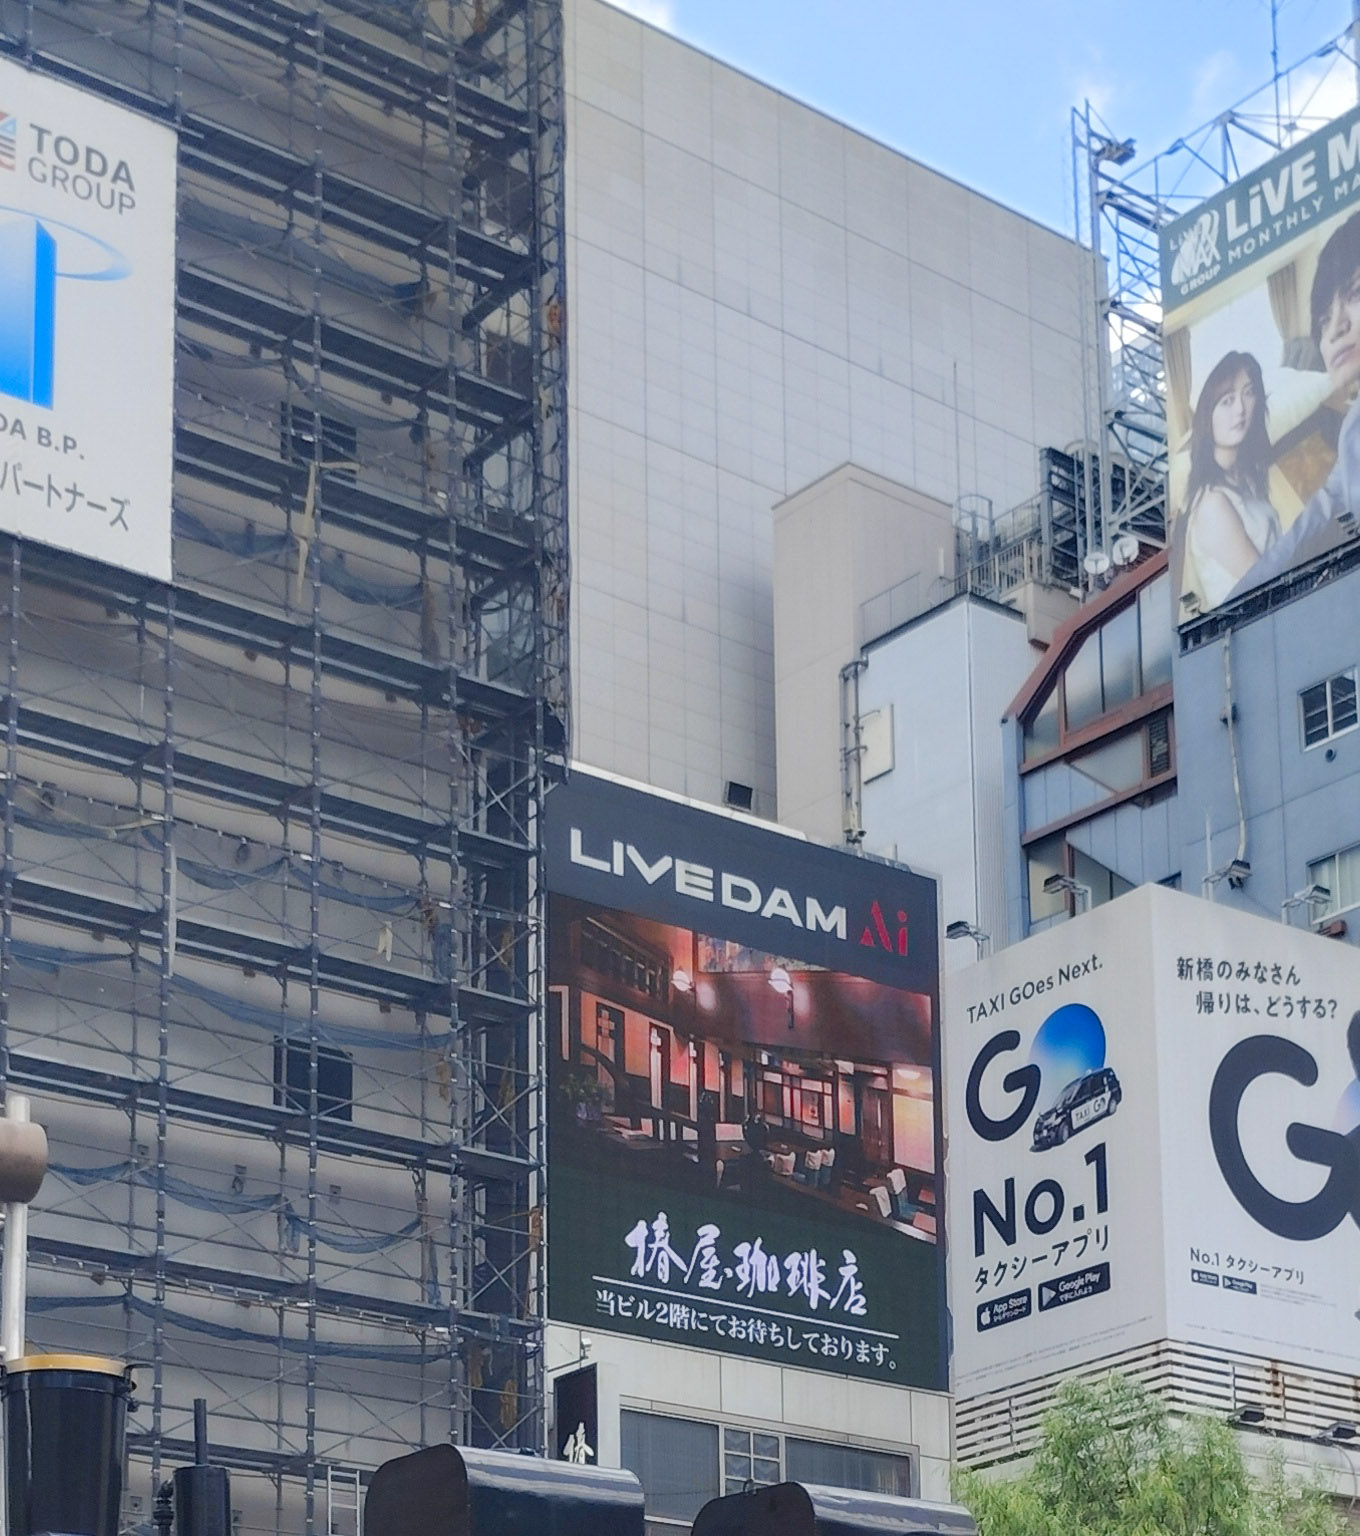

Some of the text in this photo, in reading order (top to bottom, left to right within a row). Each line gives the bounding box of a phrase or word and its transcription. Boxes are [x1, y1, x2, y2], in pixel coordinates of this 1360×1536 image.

[27, 155, 136, 216] GROUP
[29, 122, 136, 192] TODA
[1228, 195, 1324, 264] MONTHLY
[1180, 264, 1221, 296] GROUP
[37, 426, 86, 460] B.P.
[859, 899, 910, 956] Ai
[966, 953, 1103, 1024] TAXI GOes Next.
[1176, 957, 1302, 987] 新橋のみなさん
[1075, 1105, 1090, 1121] TAXI
[973, 1142, 1109, 1258] No.1
[625, 1211, 868, 1316] 椿屋珈琲店
[975, 1224, 1110, 1293] タクシーアプリ
[1058, 1271, 1101, 1292] Google Play
[1190, 1247, 1220, 1266] No.1
[1226, 1254, 1305, 1285] タクシーアプリ
[595, 1289, 898, 1371] 当ビル2階にてお待ちしております。
[993, 1295, 1028, 1314] App Store
